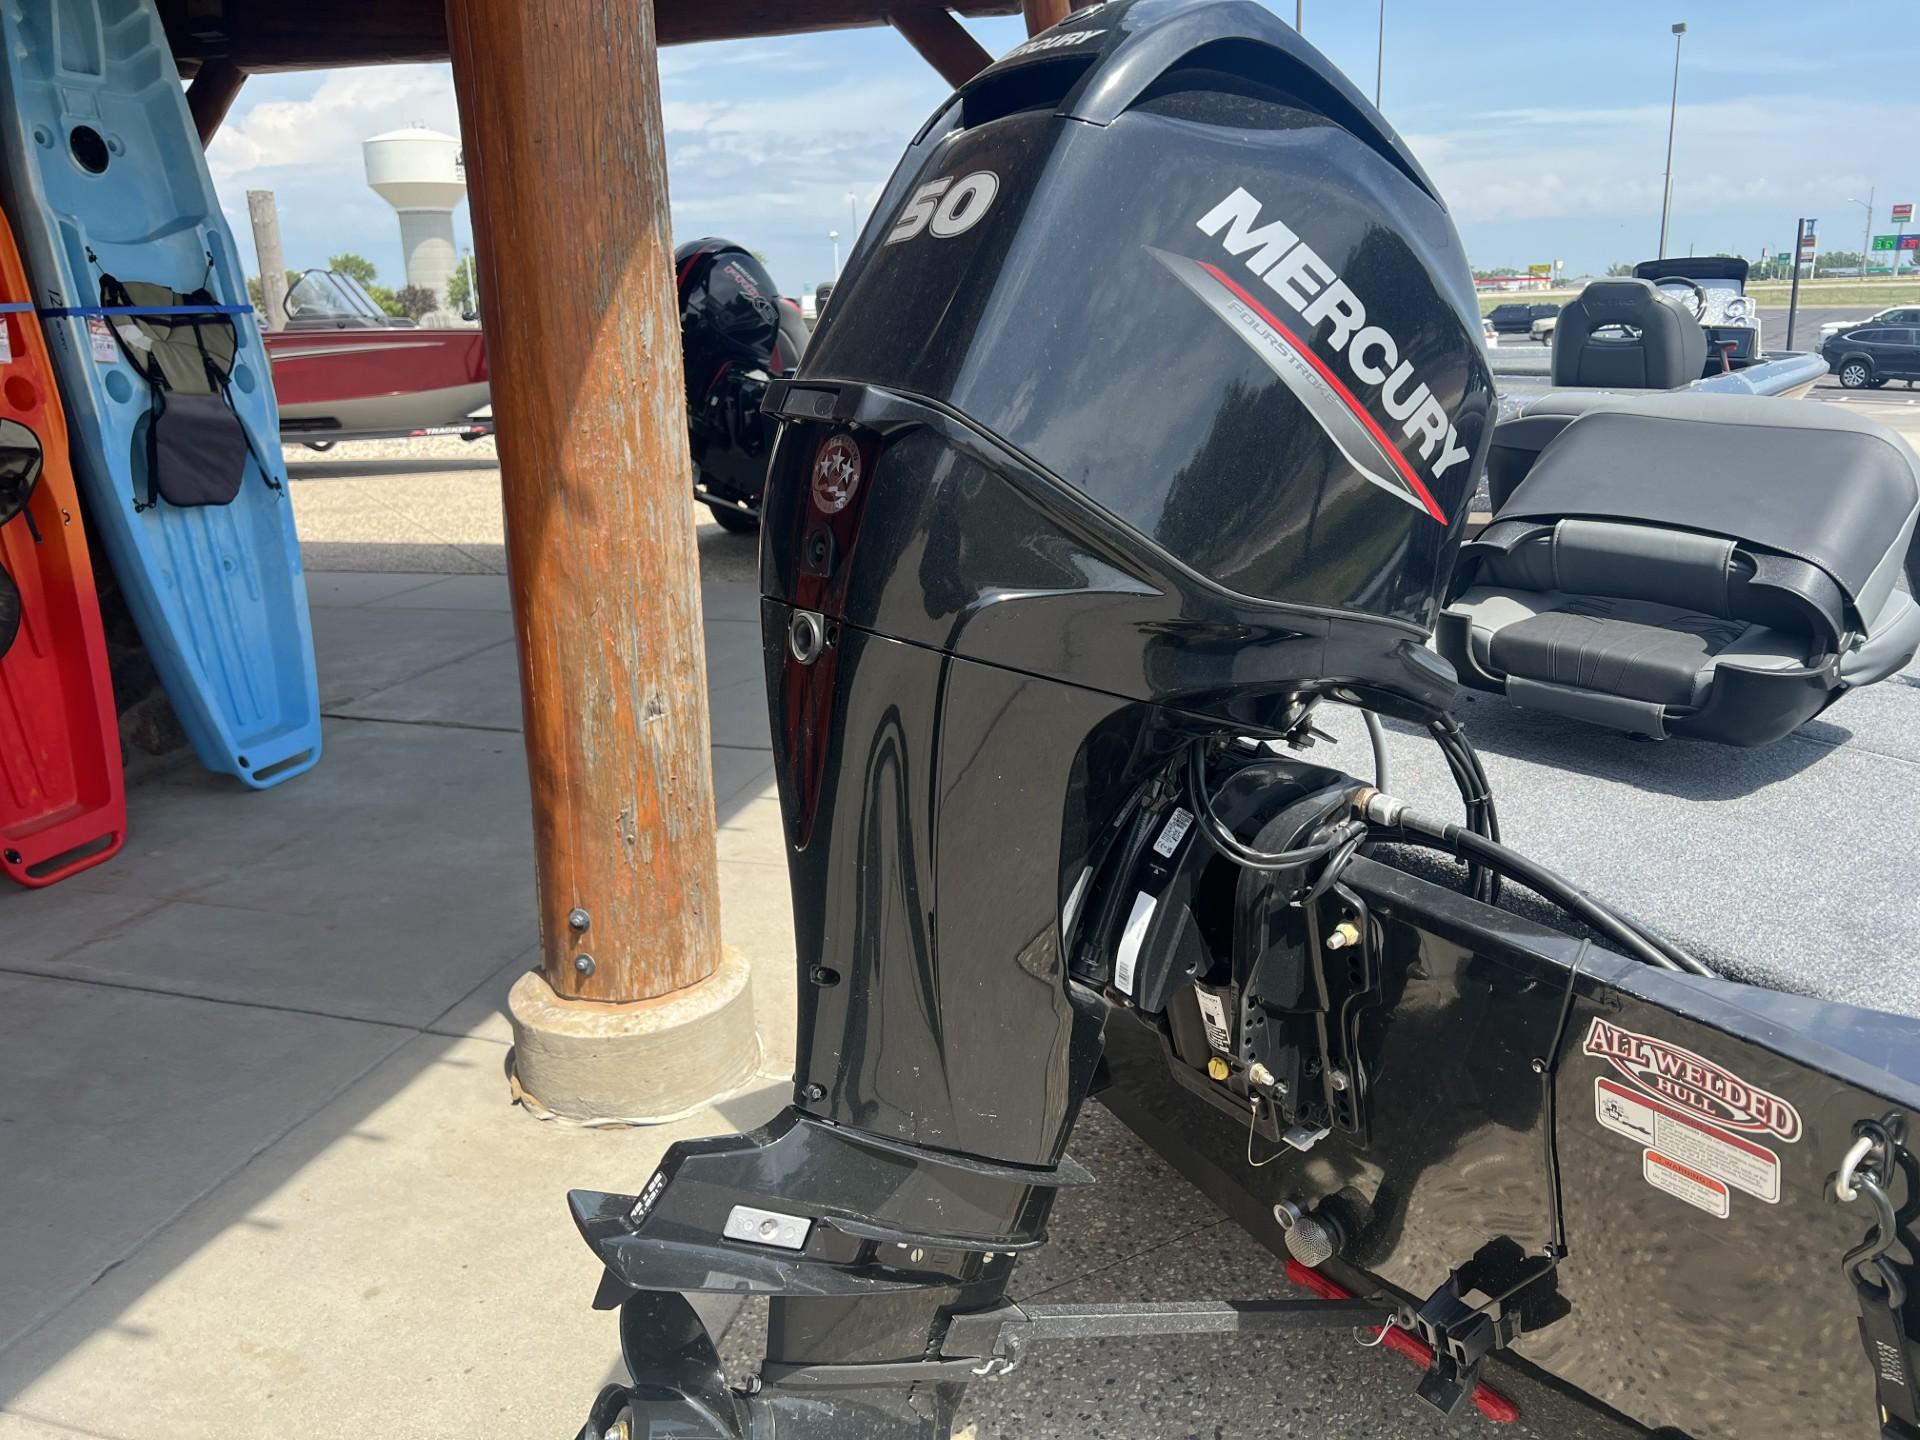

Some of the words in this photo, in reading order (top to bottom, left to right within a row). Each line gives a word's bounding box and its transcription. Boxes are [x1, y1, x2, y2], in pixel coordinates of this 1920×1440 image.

[883, 170, 1000, 247] 50
[1196, 186, 1470, 480] MERCURY
[1227, 299, 1337, 404] FOURSTROKE
[1588, 1022, 1651, 1068] ALL
[1651, 1047, 1796, 1137] WELDED
[1655, 1075, 1718, 1115] HULL
[1662, 1158, 1709, 1185] WARNING
